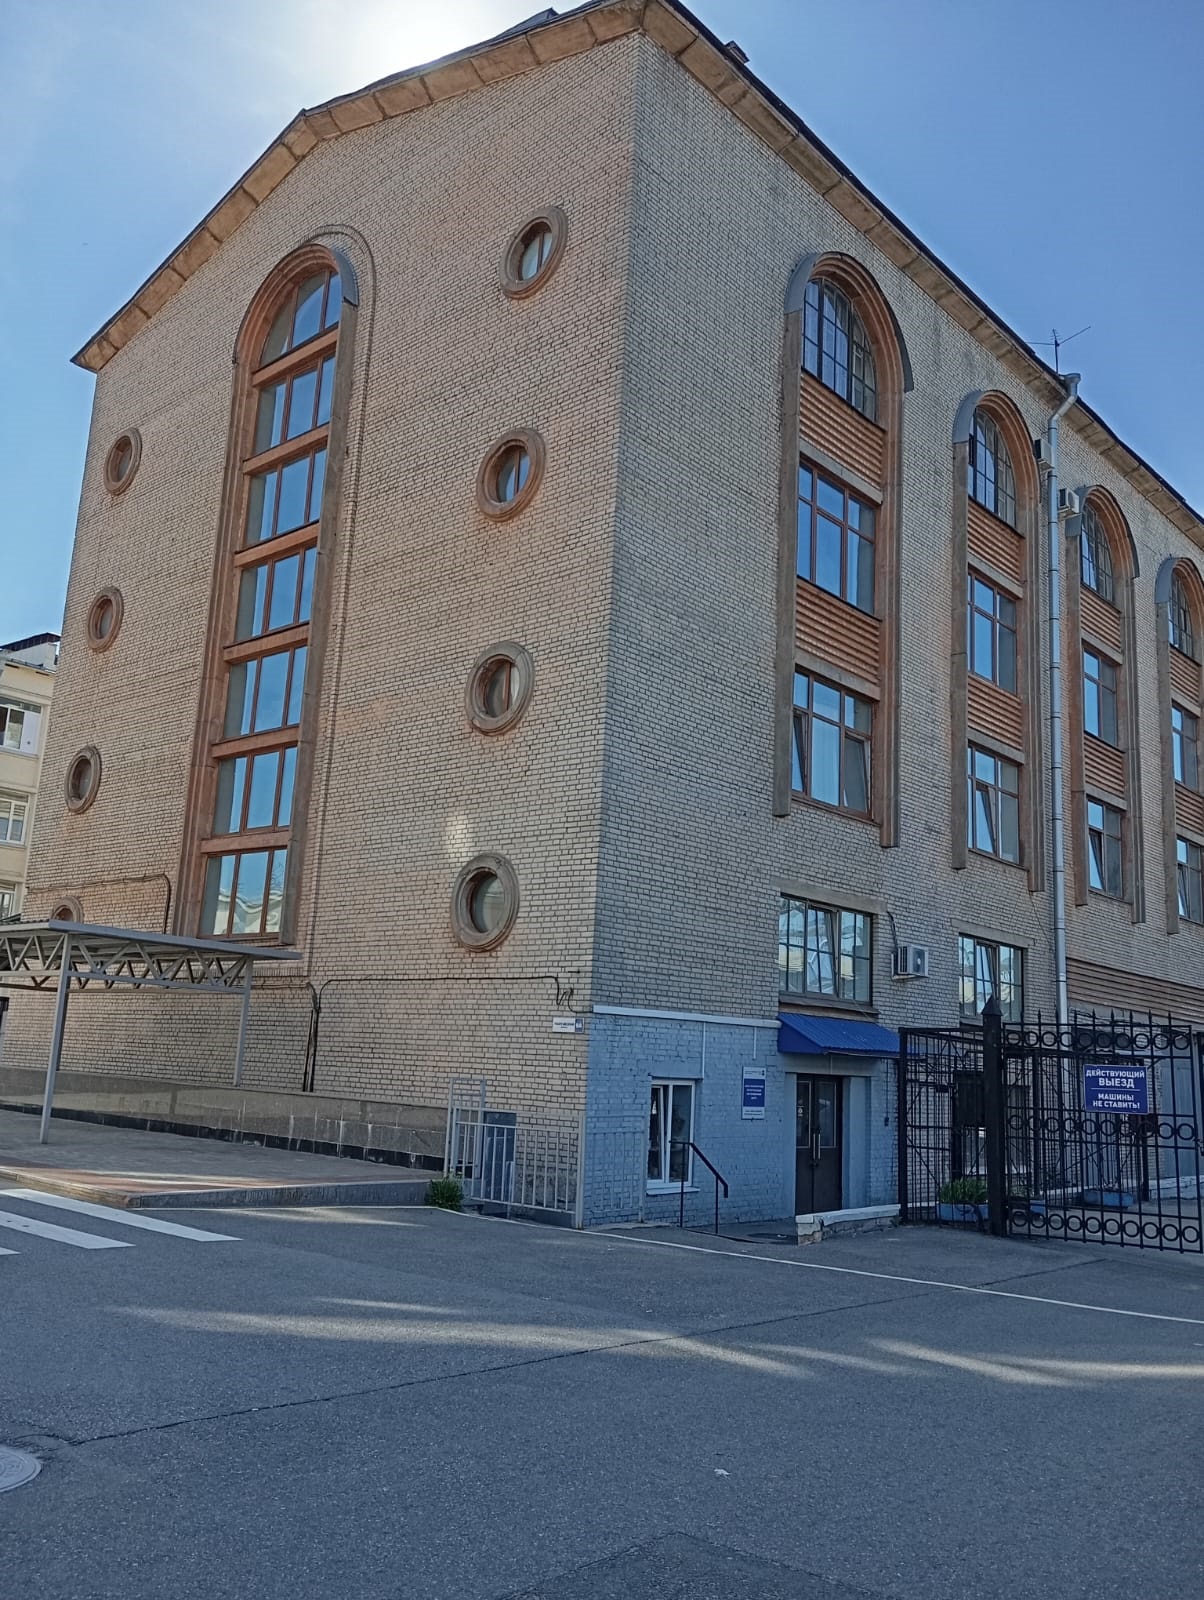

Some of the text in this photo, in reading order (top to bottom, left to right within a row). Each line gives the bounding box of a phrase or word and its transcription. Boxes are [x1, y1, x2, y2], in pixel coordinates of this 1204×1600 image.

[1086, 1069, 1145, 1078] ДЕЙСТВУЮЩИЙ
[1098, 1078, 1135, 1088] ВЫЕЗД
[1098, 1093, 1134, 1101] МАШИНЫ
[1104, 1101, 1140, 1109] СТАВИТЬ!
